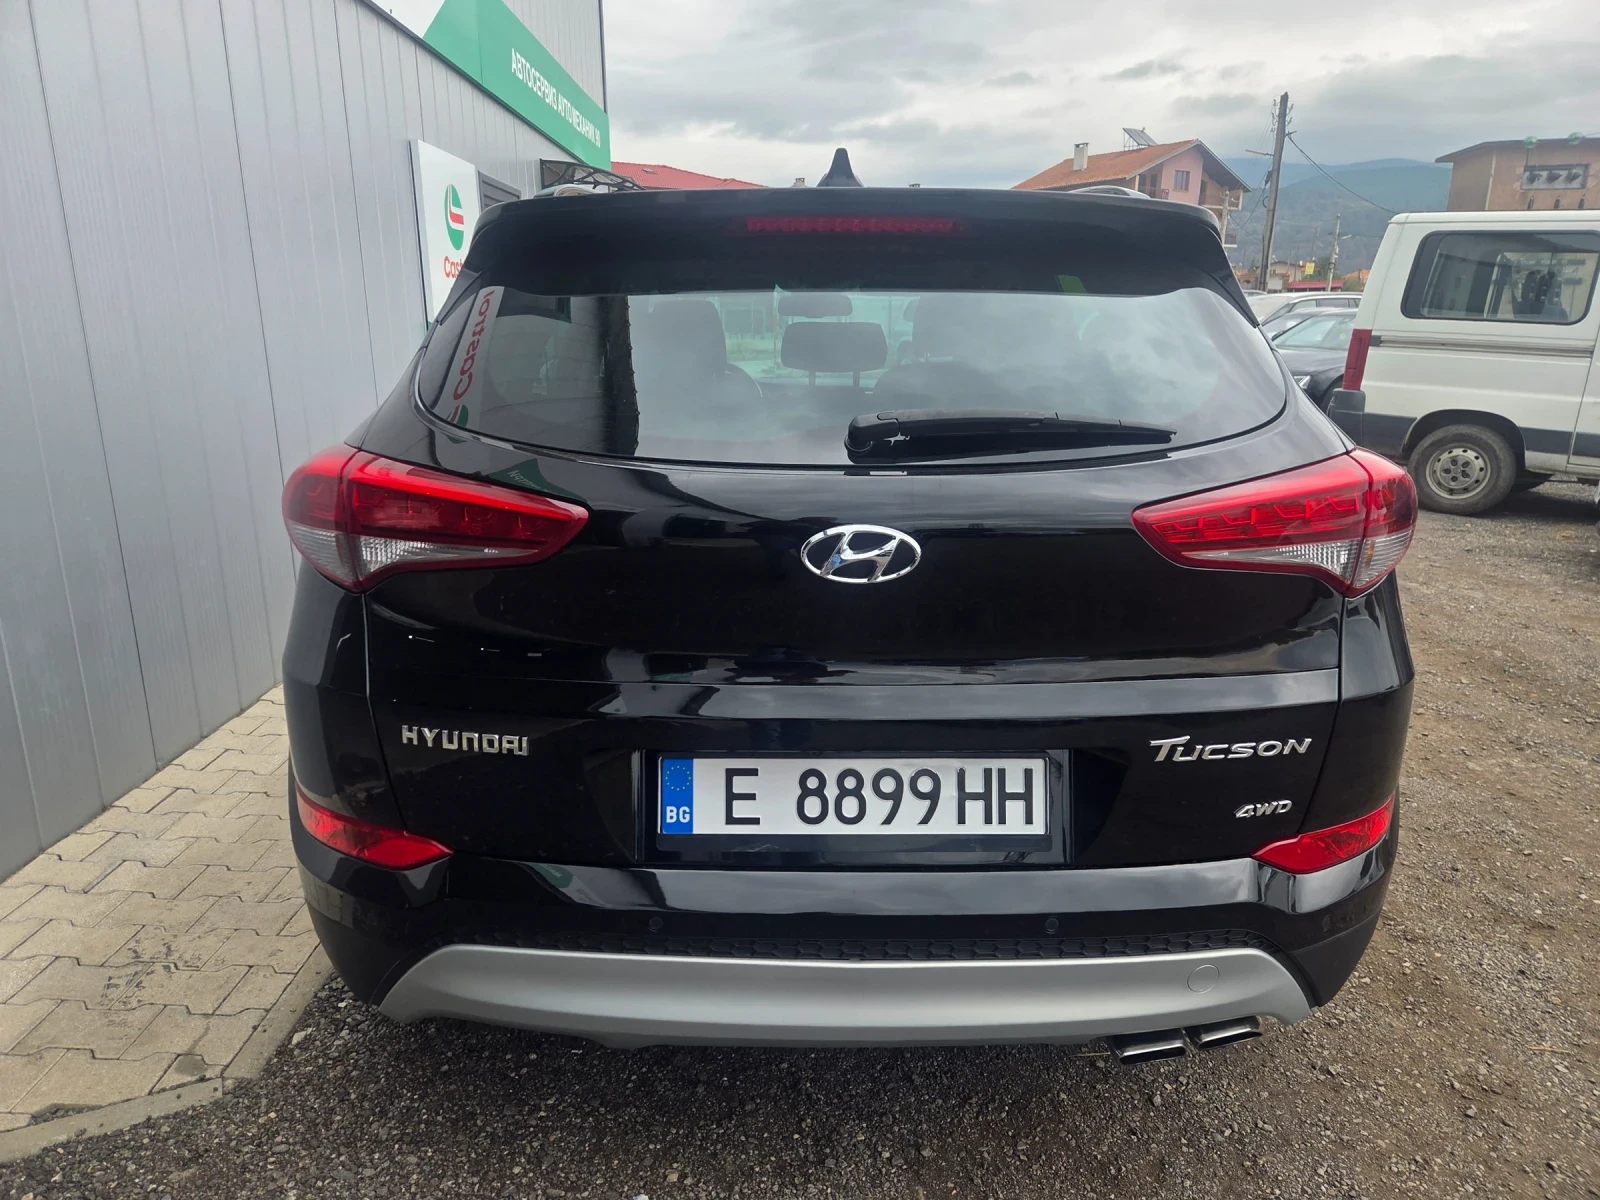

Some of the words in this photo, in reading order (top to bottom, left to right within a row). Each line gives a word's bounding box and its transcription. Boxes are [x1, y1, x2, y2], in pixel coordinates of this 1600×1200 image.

[511, 47, 557, 111] АВТОСЕРВИЗ
[402, 725, 529, 756] HYUNDAI
[725, 768, 761, 825] E
[796, 768, 941, 825] 8899
[957, 767, 1033, 825] HH
[1234, 799, 1292, 818] 4WD
[666, 806, 690, 823] BG
